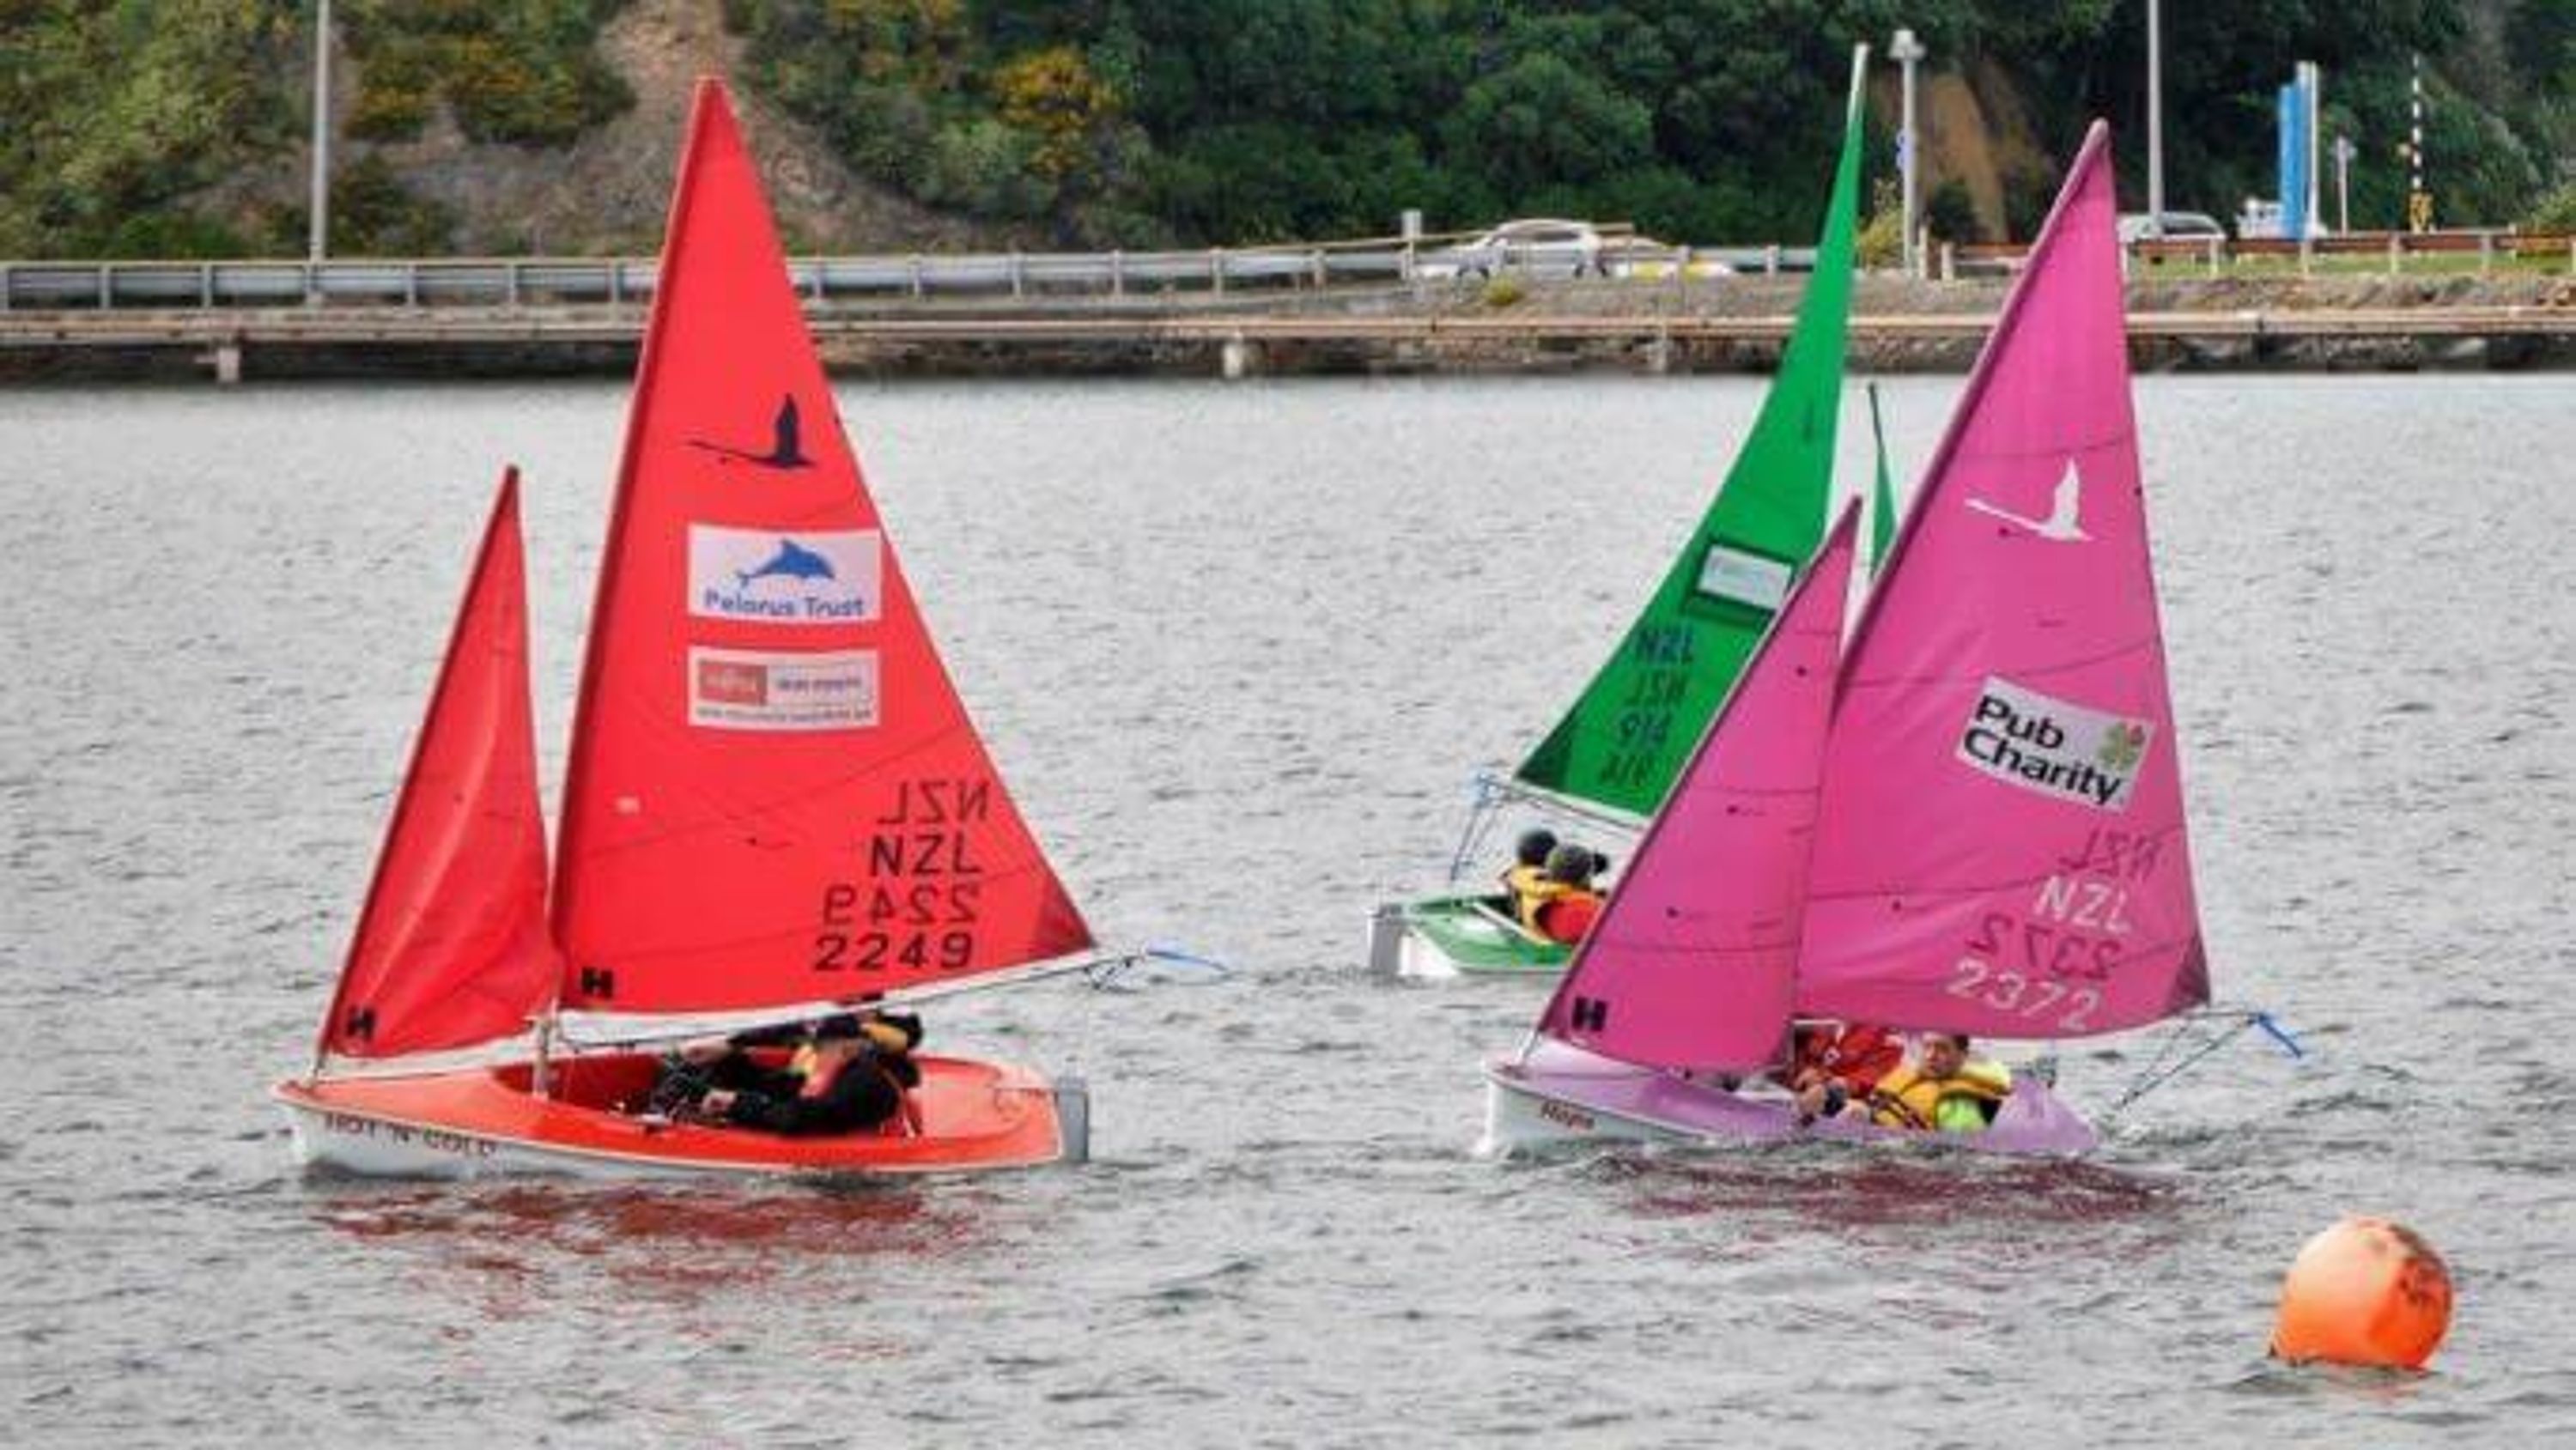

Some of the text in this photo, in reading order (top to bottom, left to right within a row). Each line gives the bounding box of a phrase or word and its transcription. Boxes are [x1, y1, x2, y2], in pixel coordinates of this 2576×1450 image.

[704, 589, 865, 617] Pelorus Trust
[1974, 695, 2063, 749] Pub
[1963, 727, 2126, 806] Charity
[869, 829, 981, 877] NZL
[2033, 874, 2131, 934] NZL
[811, 931, 973, 972] 2249
[1946, 956, 2102, 1030] 2372
[324, 1113, 376, 1139] HOT
[422, 1125, 498, 1156] COLD
